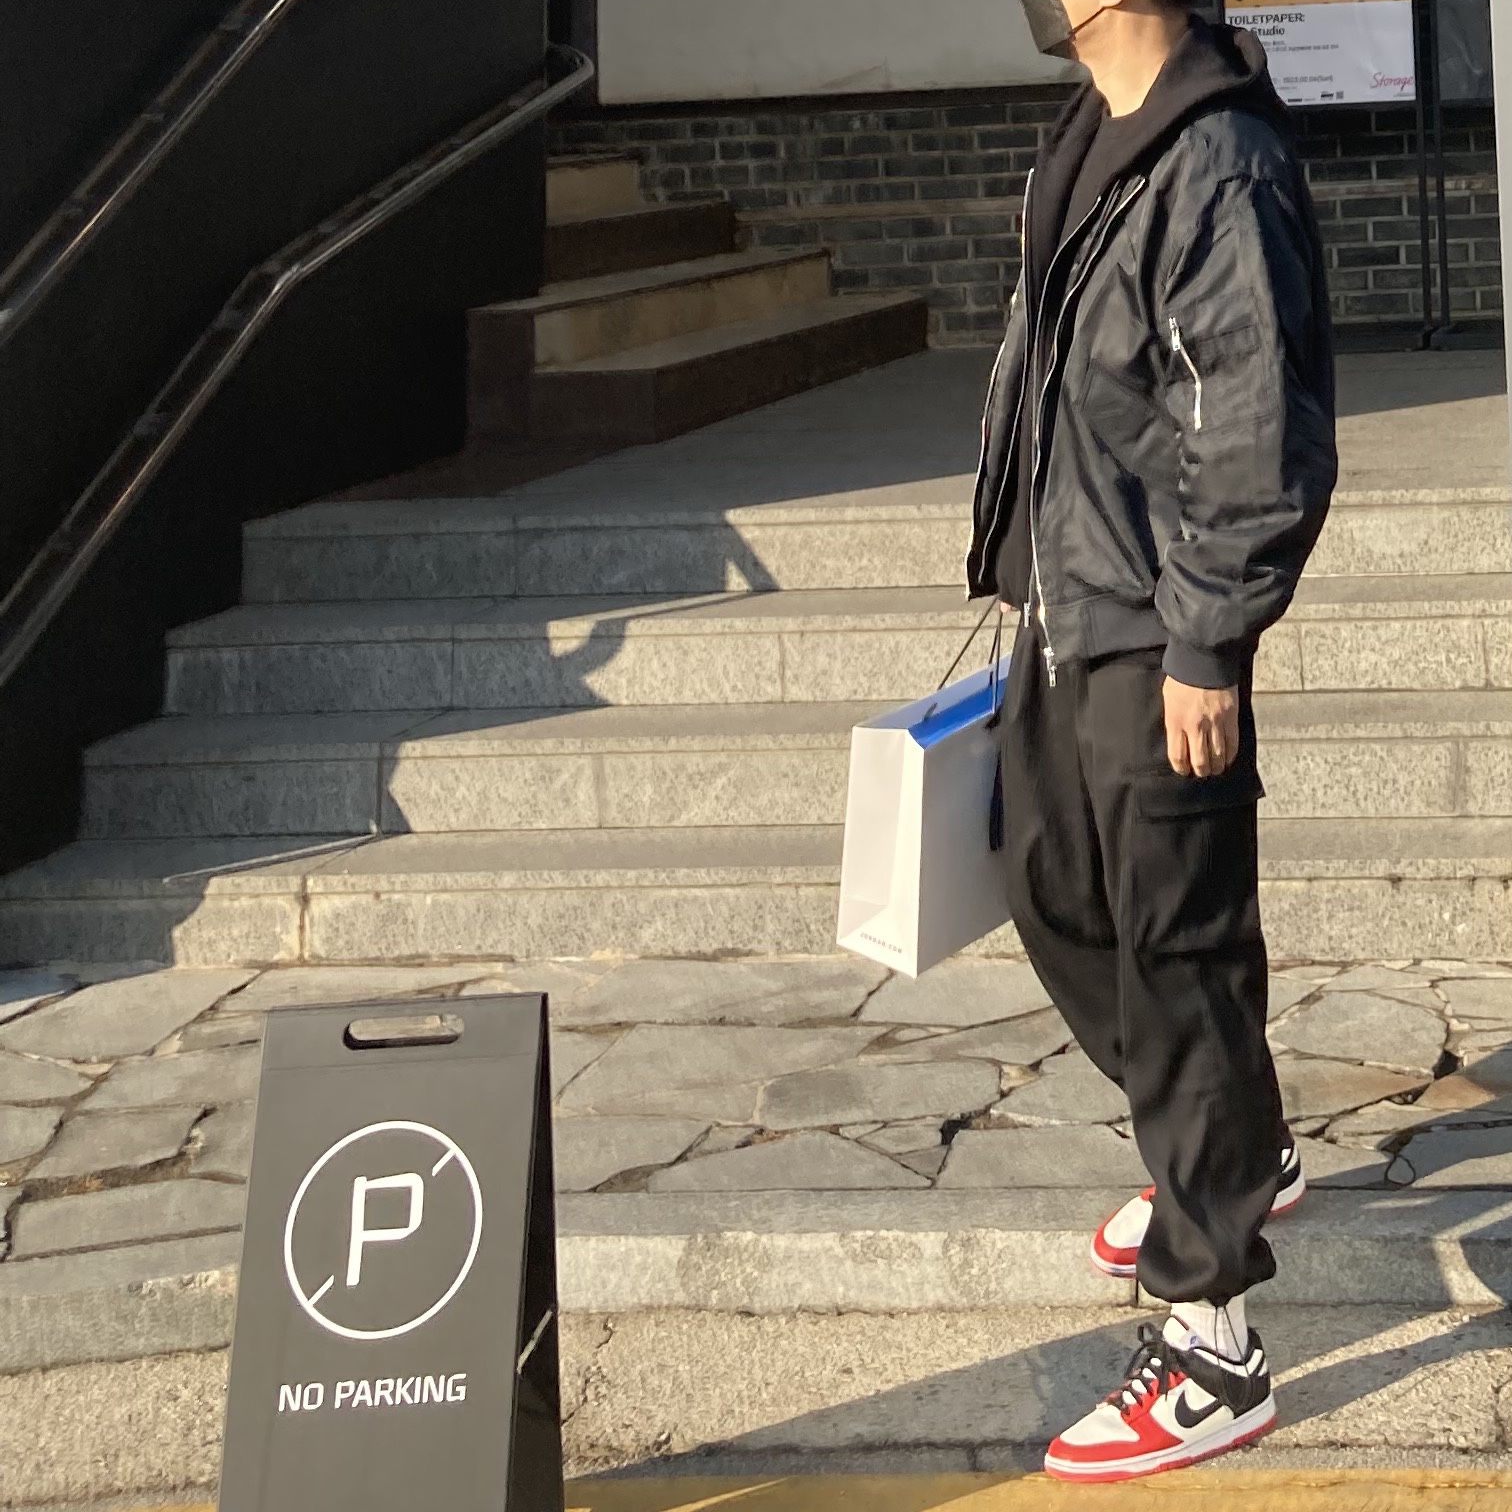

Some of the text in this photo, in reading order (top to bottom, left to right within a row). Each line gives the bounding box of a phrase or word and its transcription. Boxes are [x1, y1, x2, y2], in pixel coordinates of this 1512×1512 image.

[1370, 71, 1415, 92] Storage
[346, 1172, 425, 1286] P
[278, 1373, 467, 1412] NO PARKING
